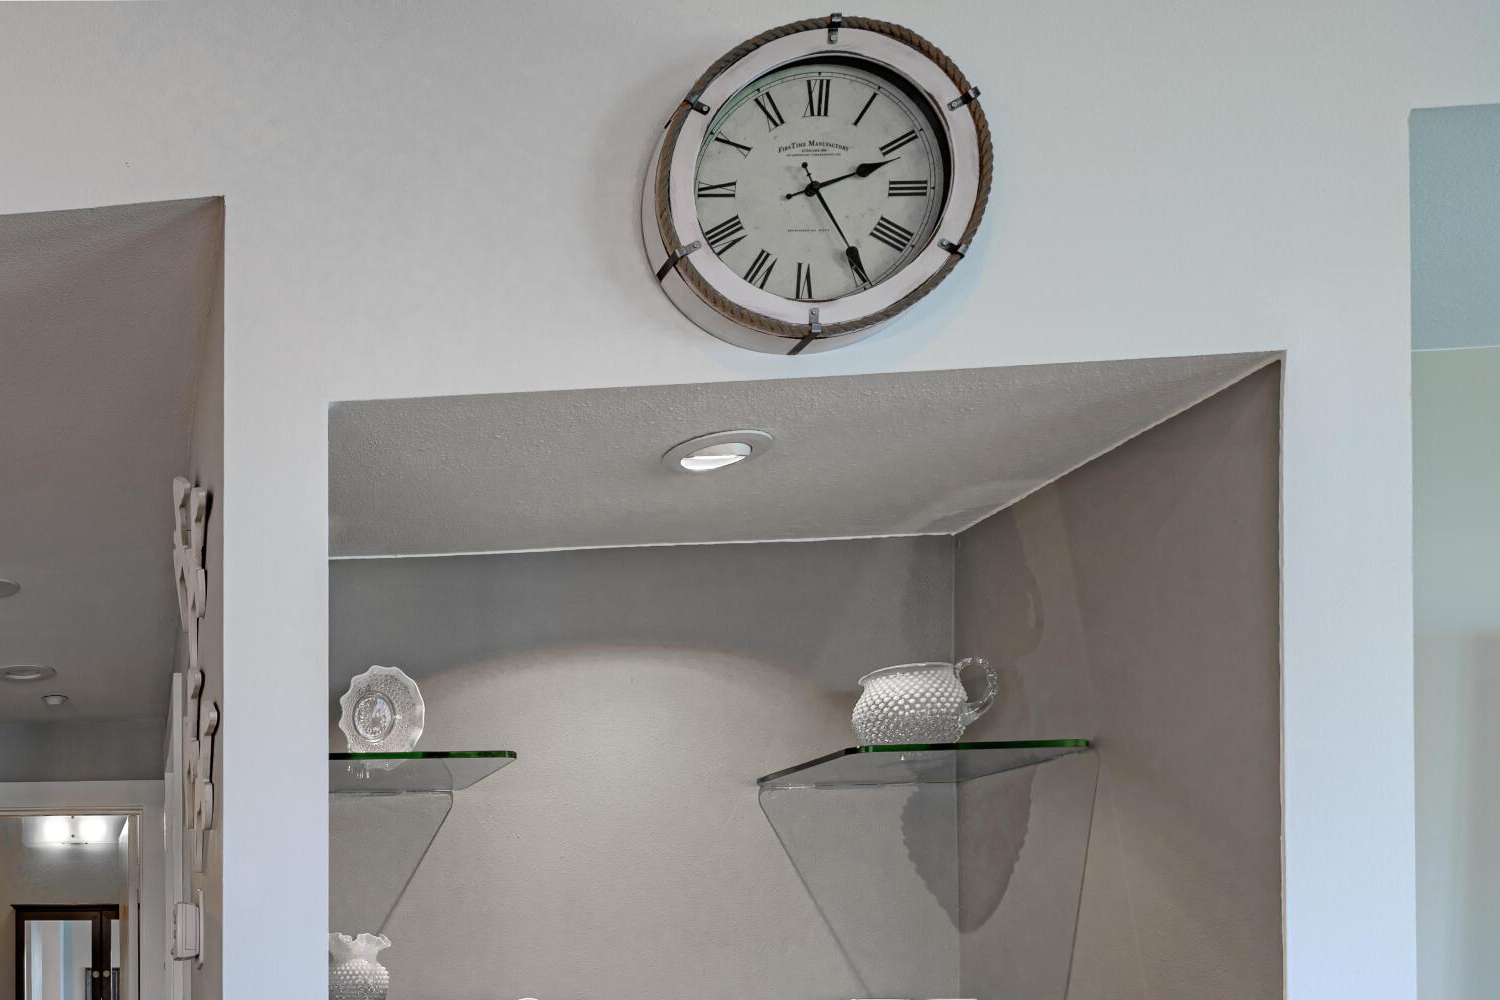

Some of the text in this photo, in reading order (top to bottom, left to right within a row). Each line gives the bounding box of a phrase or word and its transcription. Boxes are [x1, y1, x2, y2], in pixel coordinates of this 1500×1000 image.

[753, 91, 786, 132] XI
[802, 79, 831, 118] XII
[714, 131, 753, 158] X
[878, 128, 919, 156] II
[697, 180, 737, 198] IX
[888, 179, 929, 197] III
[704, 214, 748, 256] VIII
[743, 248, 778, 290] VII
[795, 262, 813, 300] VI
